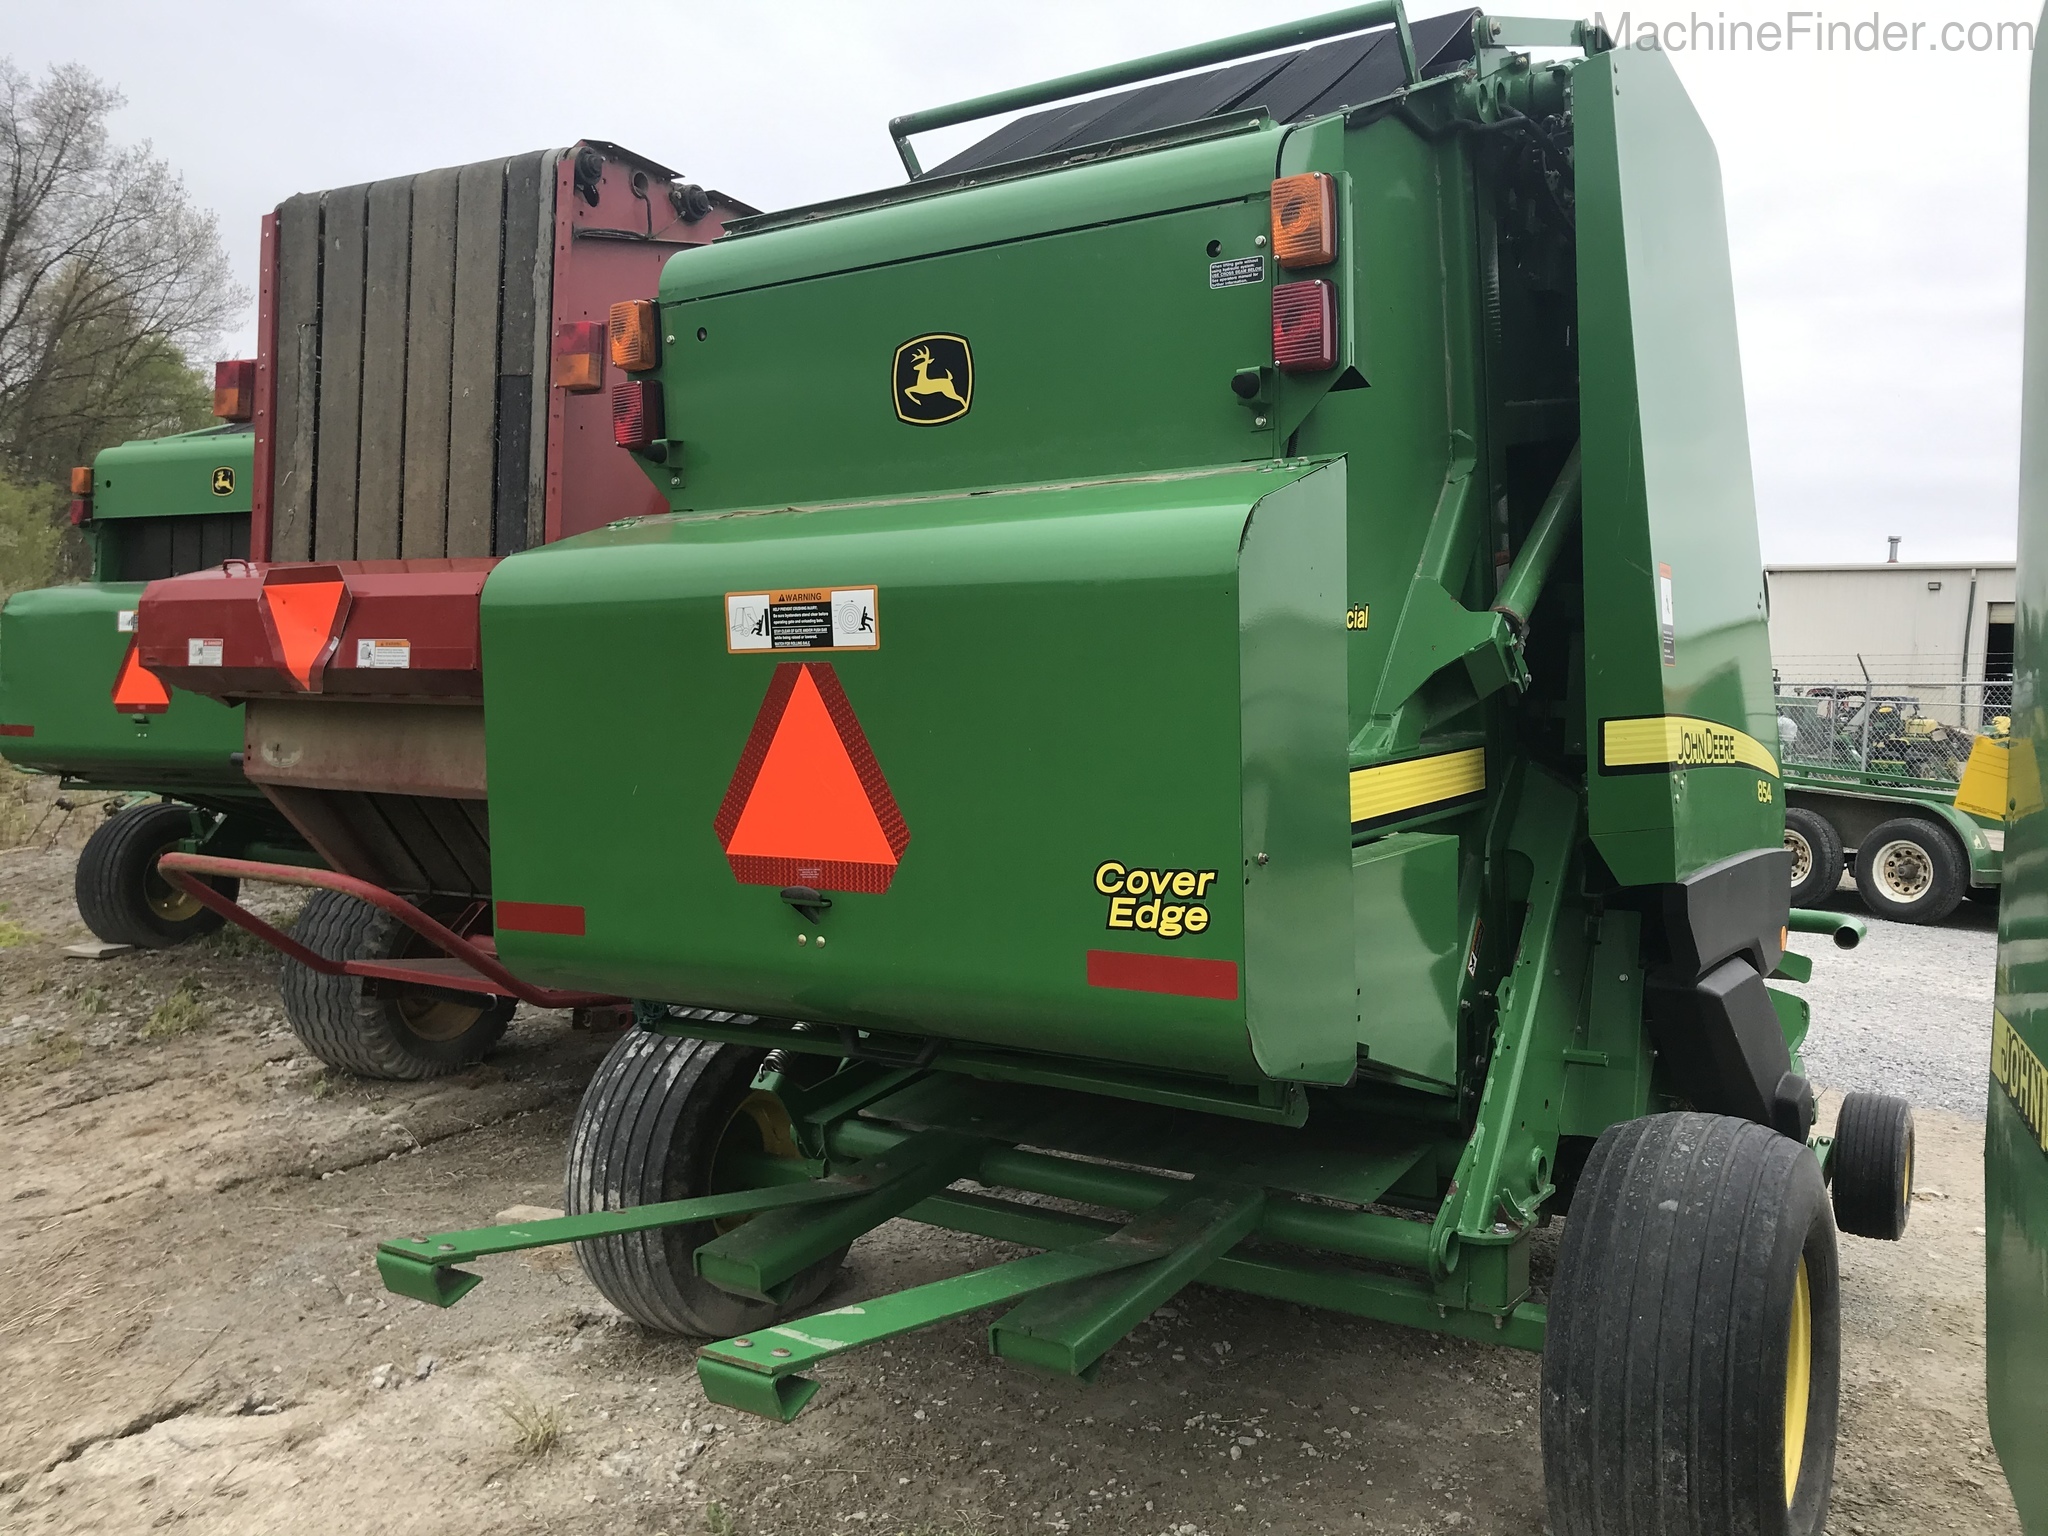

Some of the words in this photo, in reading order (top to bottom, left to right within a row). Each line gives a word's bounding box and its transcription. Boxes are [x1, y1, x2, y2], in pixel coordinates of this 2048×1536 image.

[785, 593, 822, 601] WARNING
[1757, 779, 1772, 804] 854
[1095, 861, 1217, 897] Cover
[1108, 896, 1210, 938] Edge
